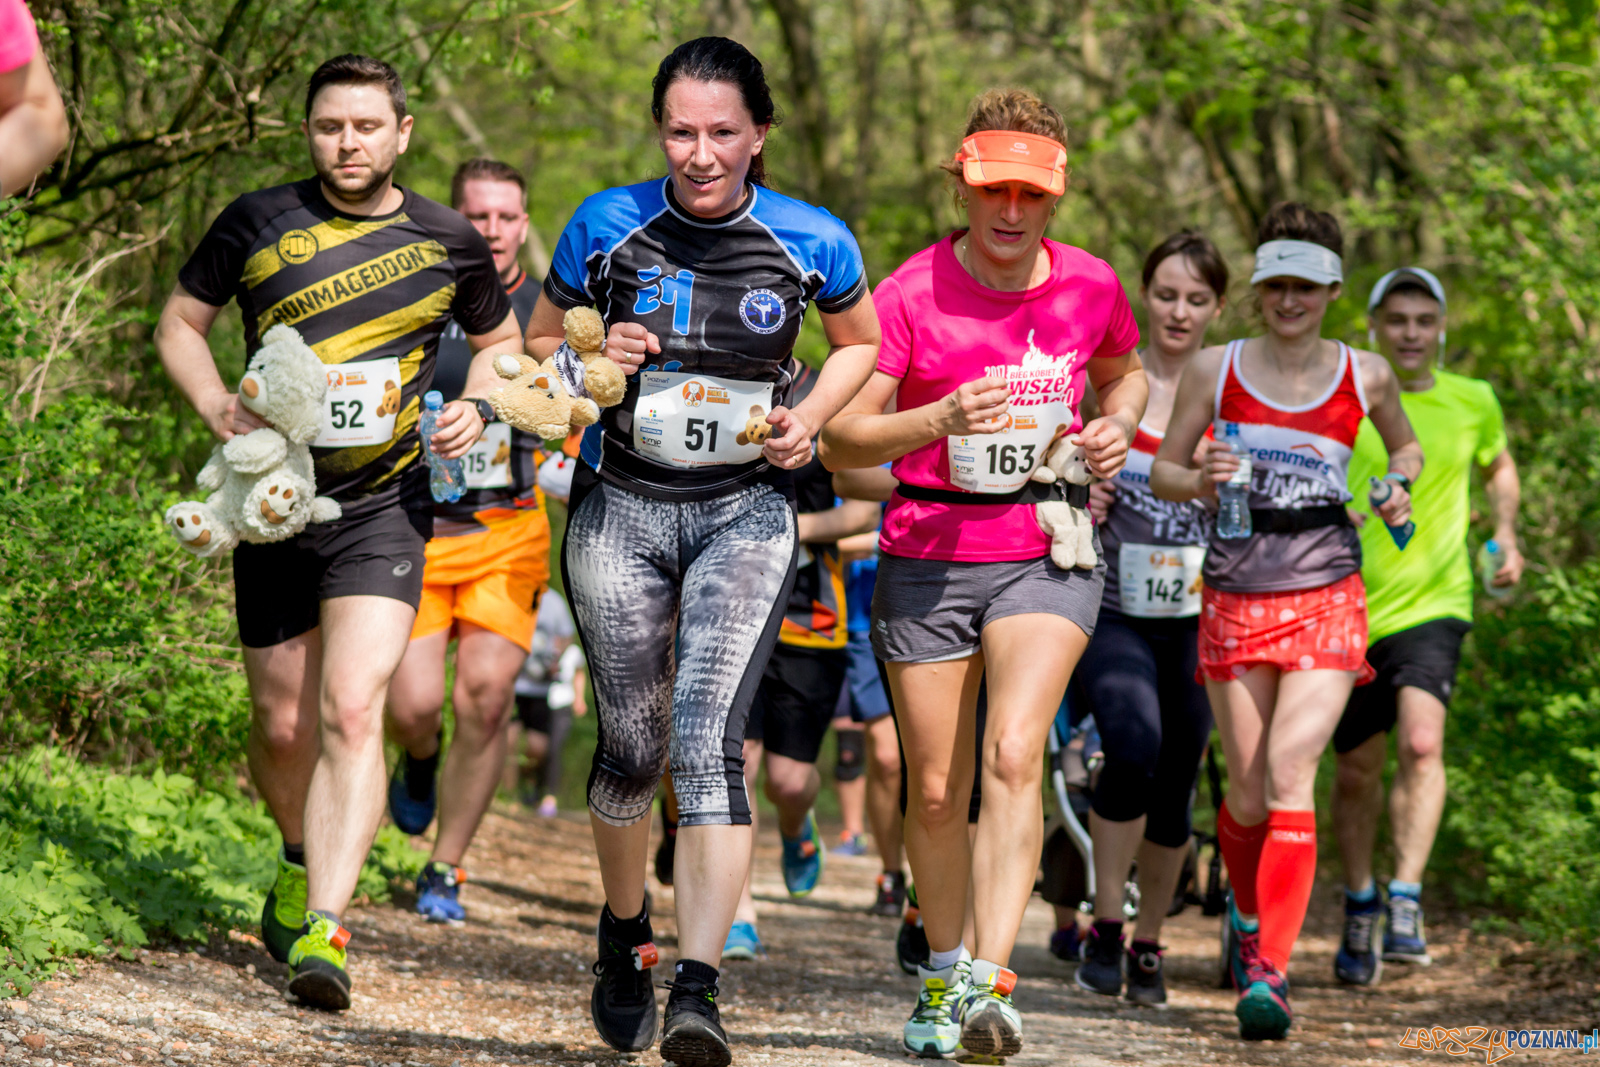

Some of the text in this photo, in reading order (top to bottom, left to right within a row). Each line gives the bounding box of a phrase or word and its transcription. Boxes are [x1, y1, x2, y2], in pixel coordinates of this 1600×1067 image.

[272, 247, 427, 323] RUNMAGEDDON
[1009, 376, 1066, 396] wsze
[1010, 369, 1029, 380] BIEG
[331, 400, 365, 430] 52
[685, 418, 719, 453] 51
[986, 444, 1036, 476] 163
[1249, 447, 1332, 475] remmers
[1149, 510, 1210, 548] TEA
[1145, 578, 1184, 602] 142
